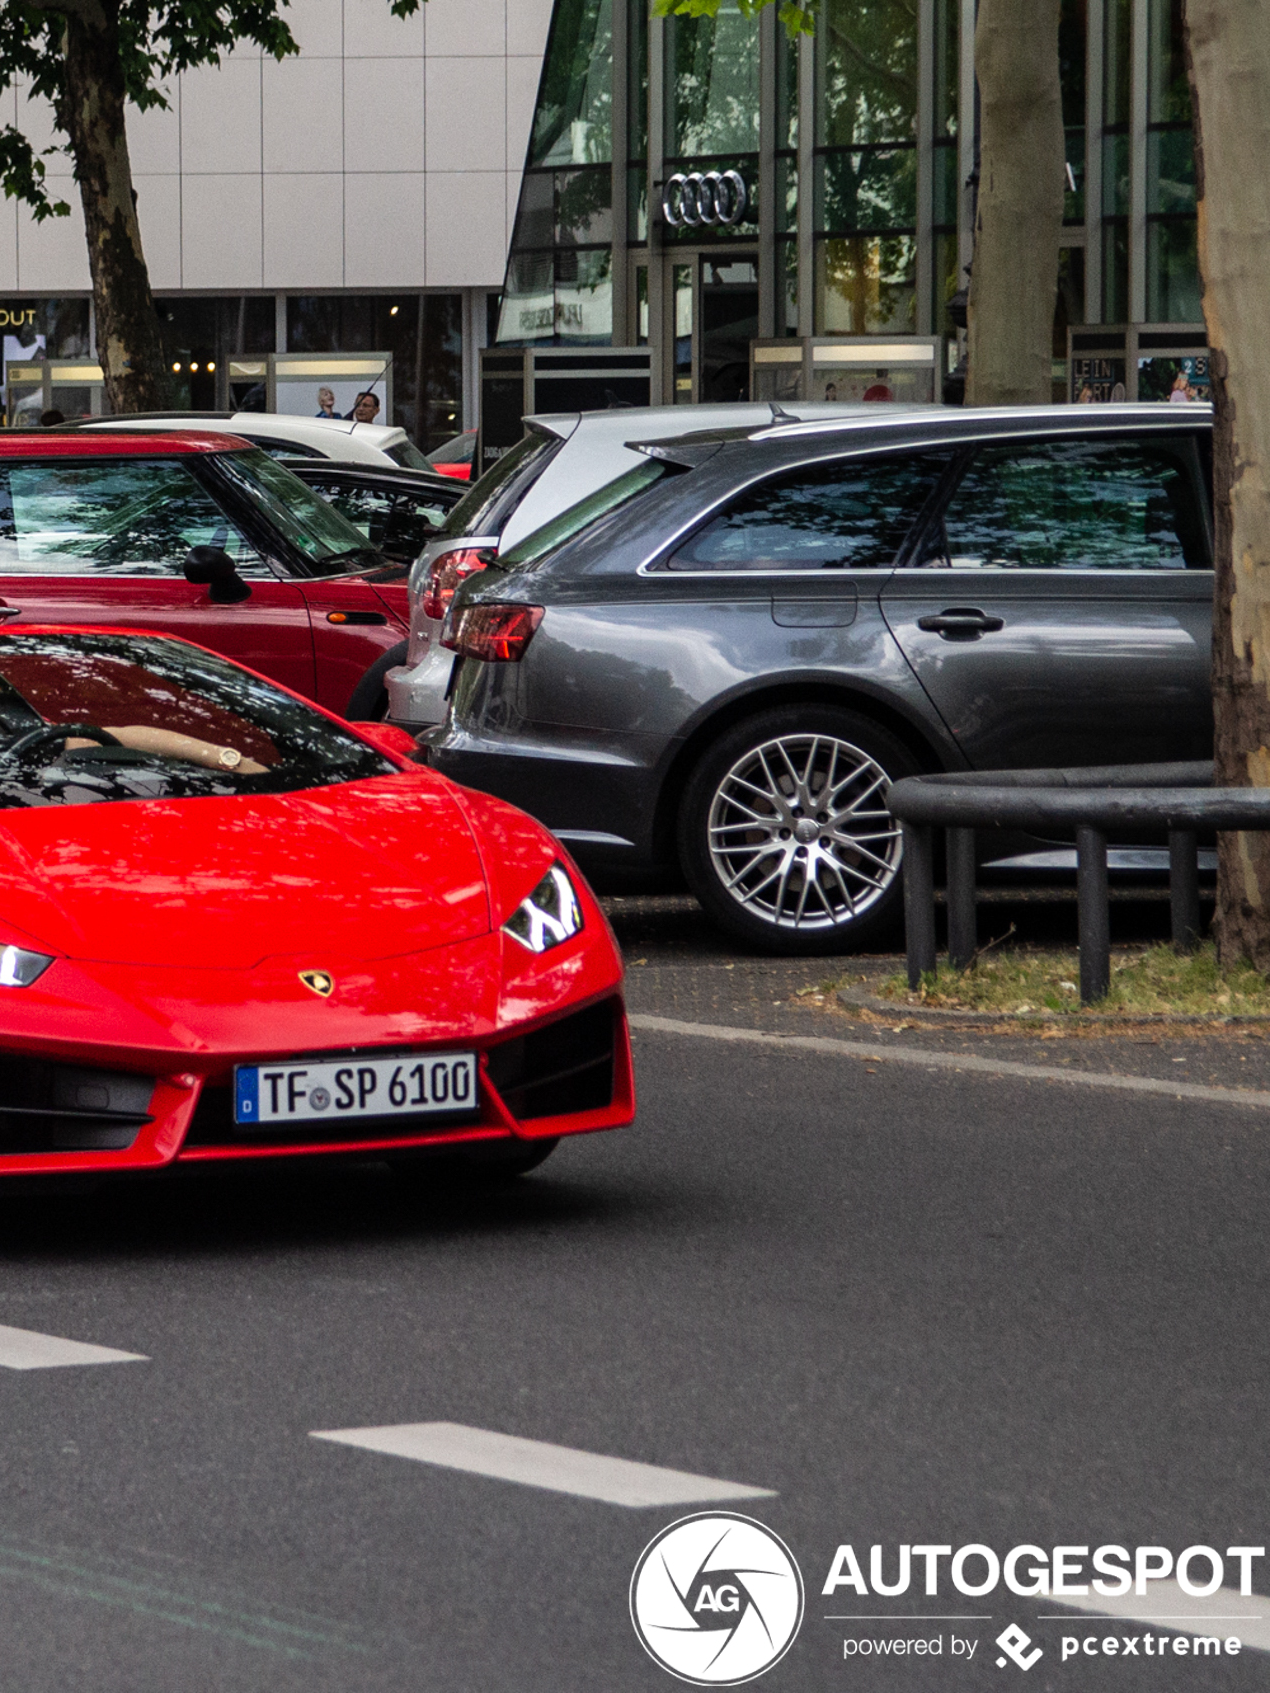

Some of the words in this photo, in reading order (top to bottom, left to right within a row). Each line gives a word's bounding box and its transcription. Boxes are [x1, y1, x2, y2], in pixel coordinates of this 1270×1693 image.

[263, 1070, 308, 1113] TF
[335, 1067, 377, 1110] SP
[388, 1061, 470, 1107] 6100
[243, 1101, 252, 1113] D
